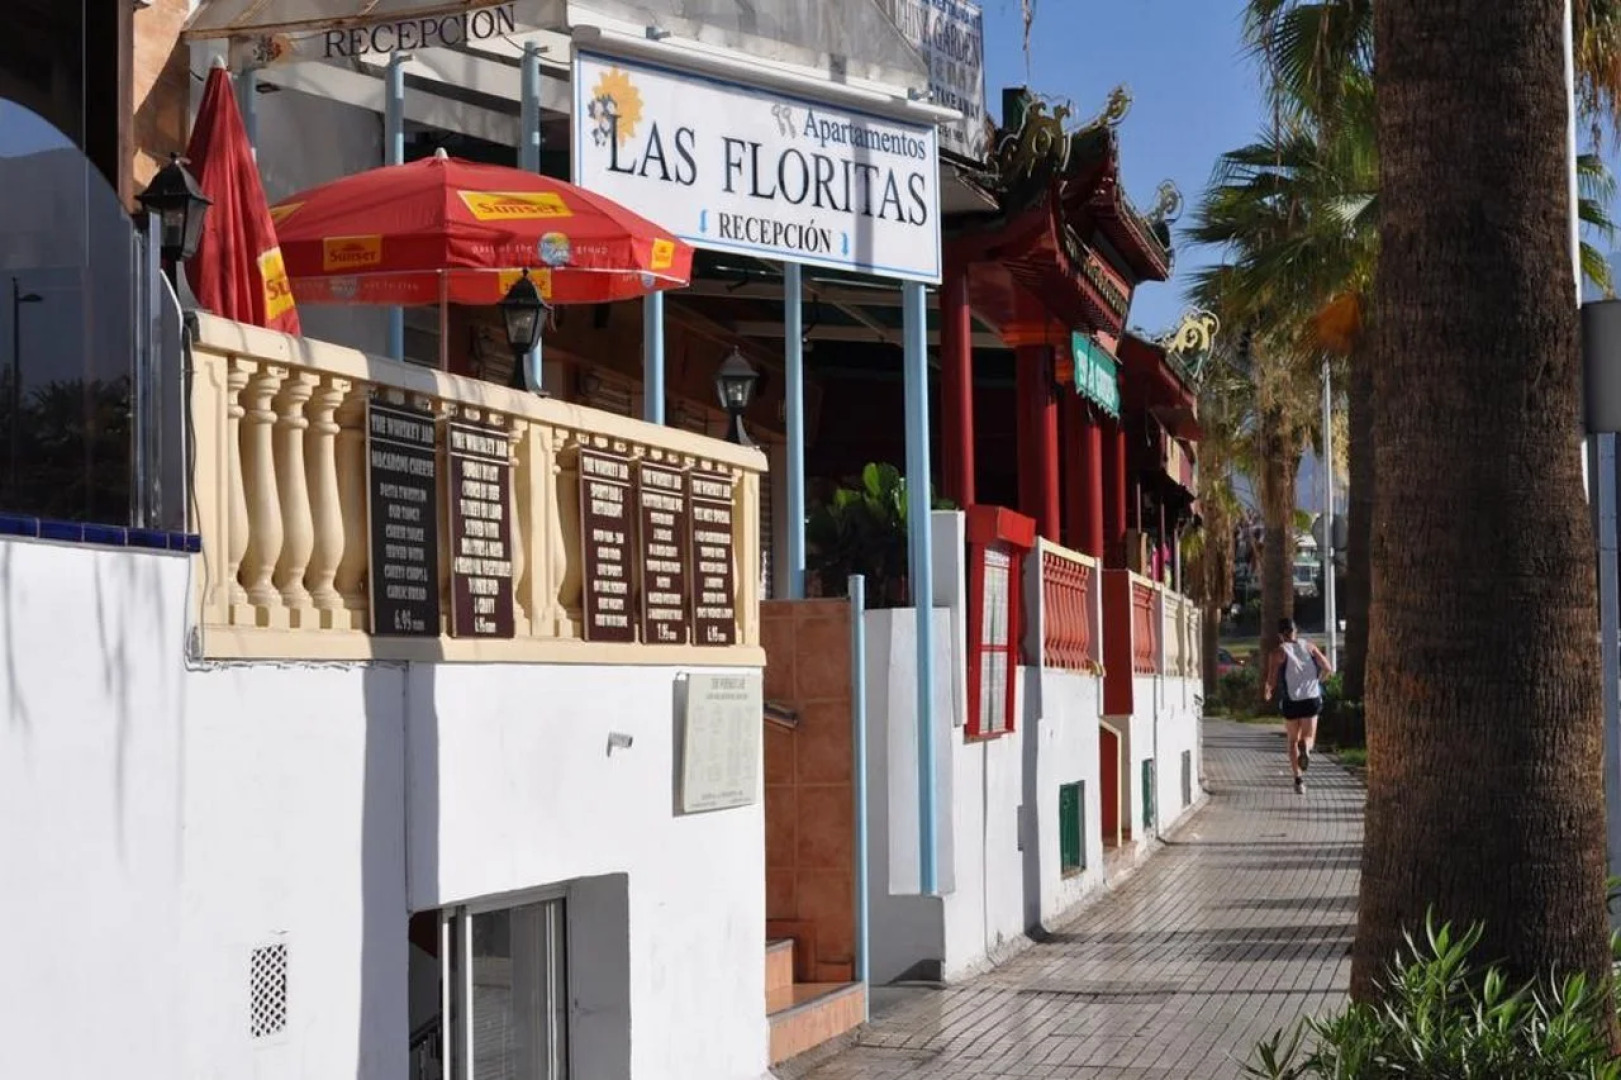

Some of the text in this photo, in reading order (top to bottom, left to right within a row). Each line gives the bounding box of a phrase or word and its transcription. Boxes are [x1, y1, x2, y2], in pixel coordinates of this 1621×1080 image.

[802, 106, 926, 161] Apartamentos
[606, 114, 928, 227] LAS FLORITAS
[477, 201, 560, 215] Sunset
[718, 211, 832, 254] RECEPCIÓN
[330, 249, 376, 264] Sunset
[371, 414, 387, 435] THE
